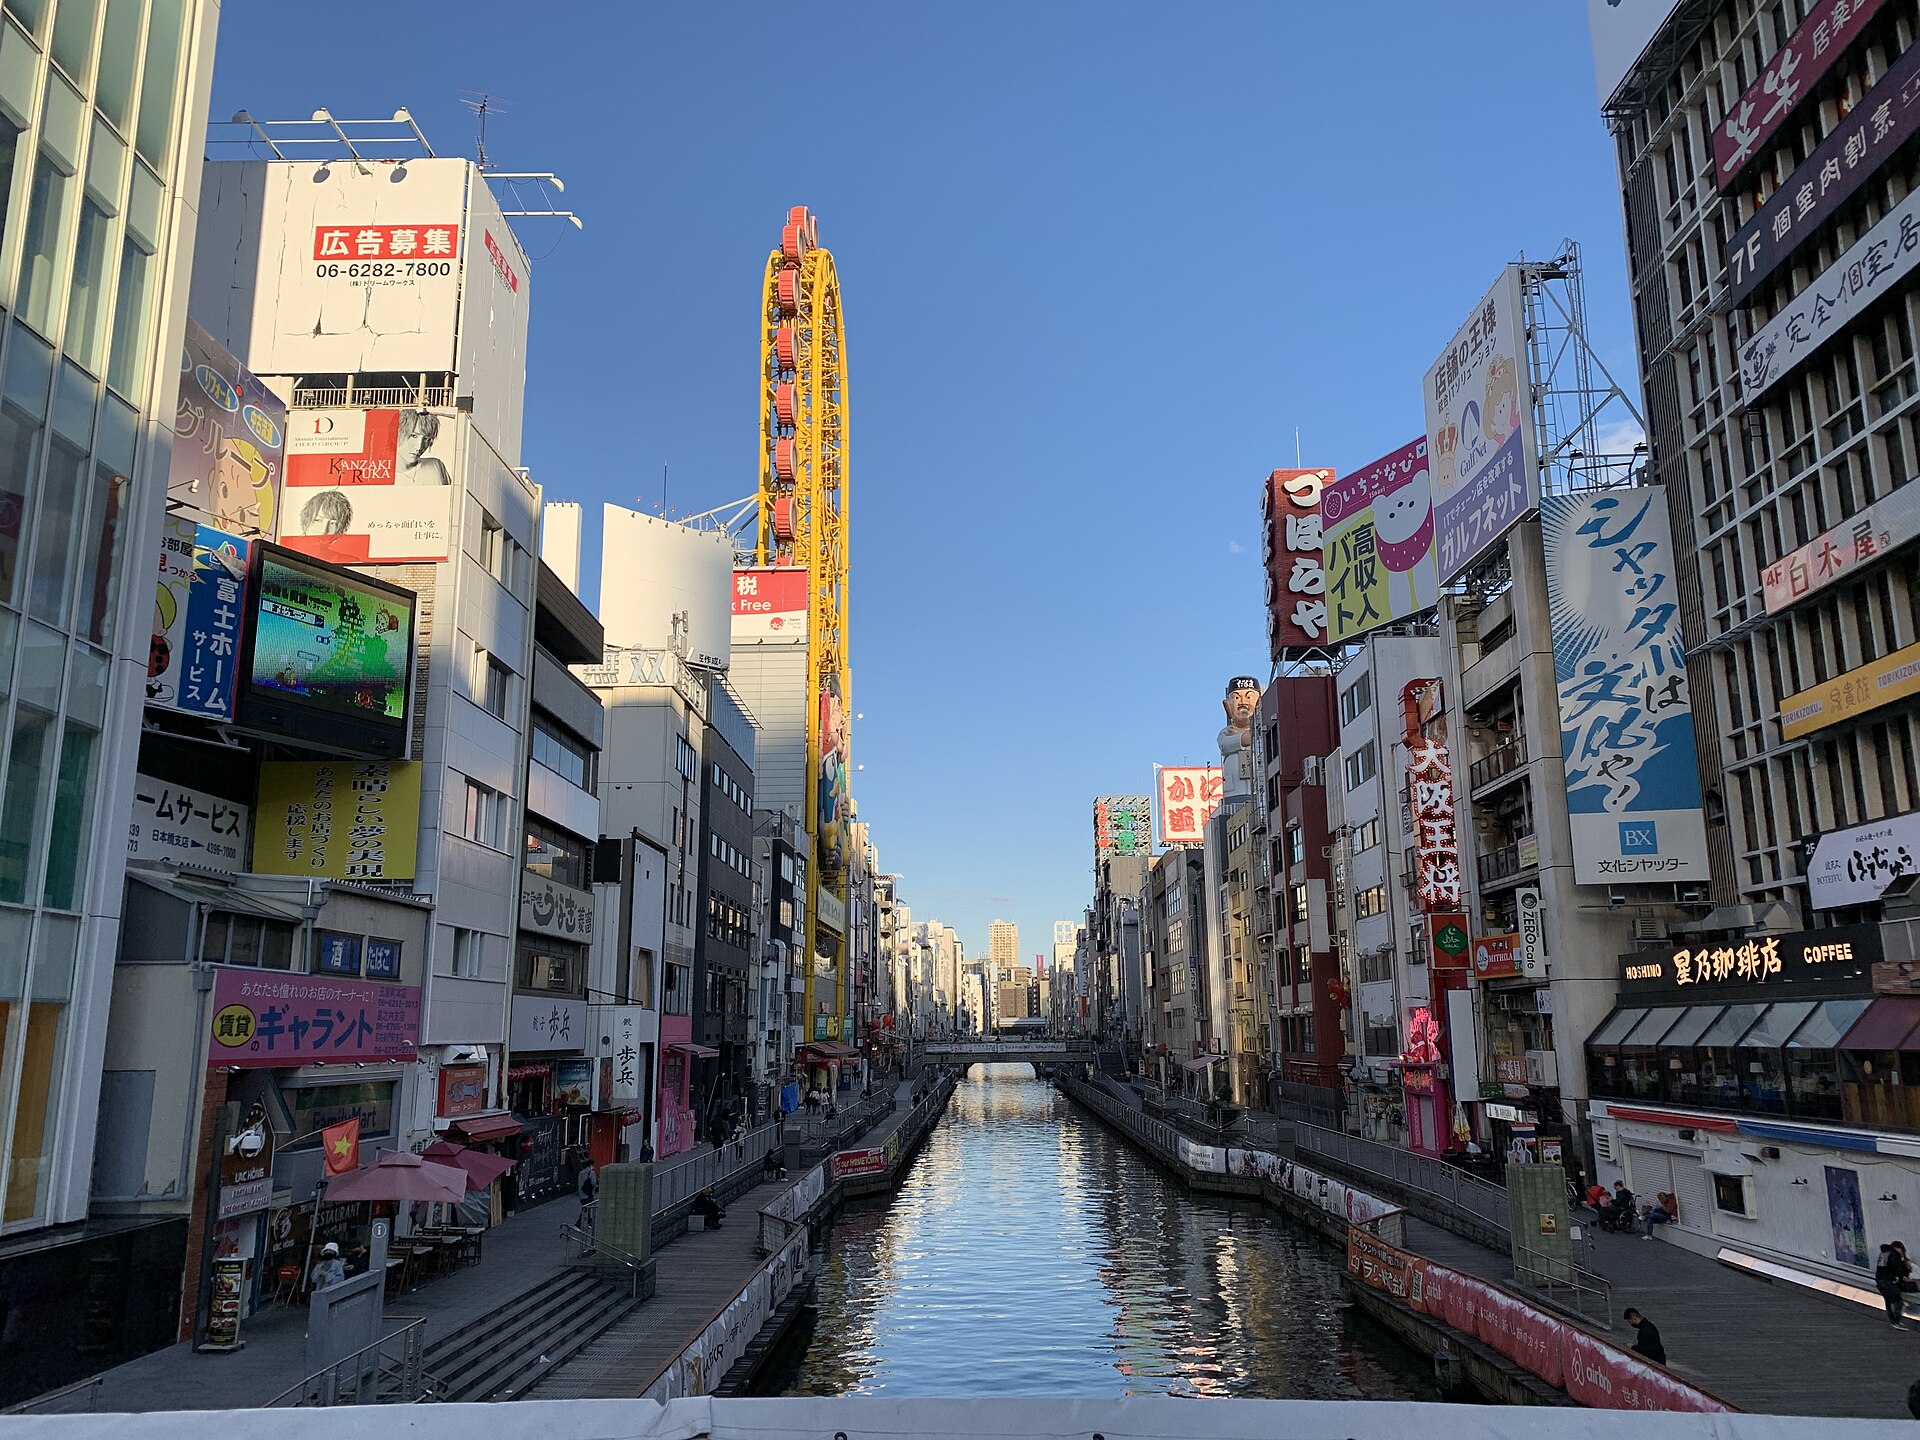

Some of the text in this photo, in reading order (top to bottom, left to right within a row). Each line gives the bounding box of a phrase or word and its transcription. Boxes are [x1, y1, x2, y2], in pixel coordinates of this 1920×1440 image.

[1723, 49, 1803, 172] 笑笑
[1731, 229, 1761, 286] 7F
[1772, 98, 1896, 243] 個室肉割烹
[319, 228, 452, 257] 広告募集
[315, 262, 451, 278] 06-6282-7800
[1435, 298, 1497, 400] 店舗の王様
[329, 458, 392, 475] KANZAKI
[351, 469, 391, 483] RUKA
[1342, 452, 1415, 503] いちごなび
[1441, 472, 1522, 572] ガルフネット
[1351, 521, 1380, 628] 高収入
[1765, 518, 1878, 599] 4F 白木屋
[740, 599, 772, 611] Free
[1328, 531, 1355, 636] バイト
[186, 629, 207, 701] サービス
[204, 576, 239, 712] 富士ホーム
[136, 789, 240, 838] ームサービス
[1167, 775, 1224, 803] かに
[151, 829, 190, 849] 日本橋支店
[282, 803, 308, 861] 応援します
[309, 765, 335, 870] あなたのお店づくり
[345, 763, 390, 879] 素晴らしい夢の実現
[1409, 739, 1461, 903] 大阪王将
[1624, 829, 1653, 846] BX
[1804, 842, 1816, 855] 2F
[532, 883, 578, 934] うなぎ
[1523, 911, 1537, 944] ZERO
[329, 941, 344, 968] 酒
[366, 945, 391, 972] たばこ
[1625, 937, 1854, 986] HOSHINO 星乃珈琲店 COFFEE
[218, 1013, 252, 1038] 賃貸
[250, 1040, 260, 1052] の
[256, 1003, 374, 1051] ギャラント
[615, 1045, 637, 1086] 歩兵
